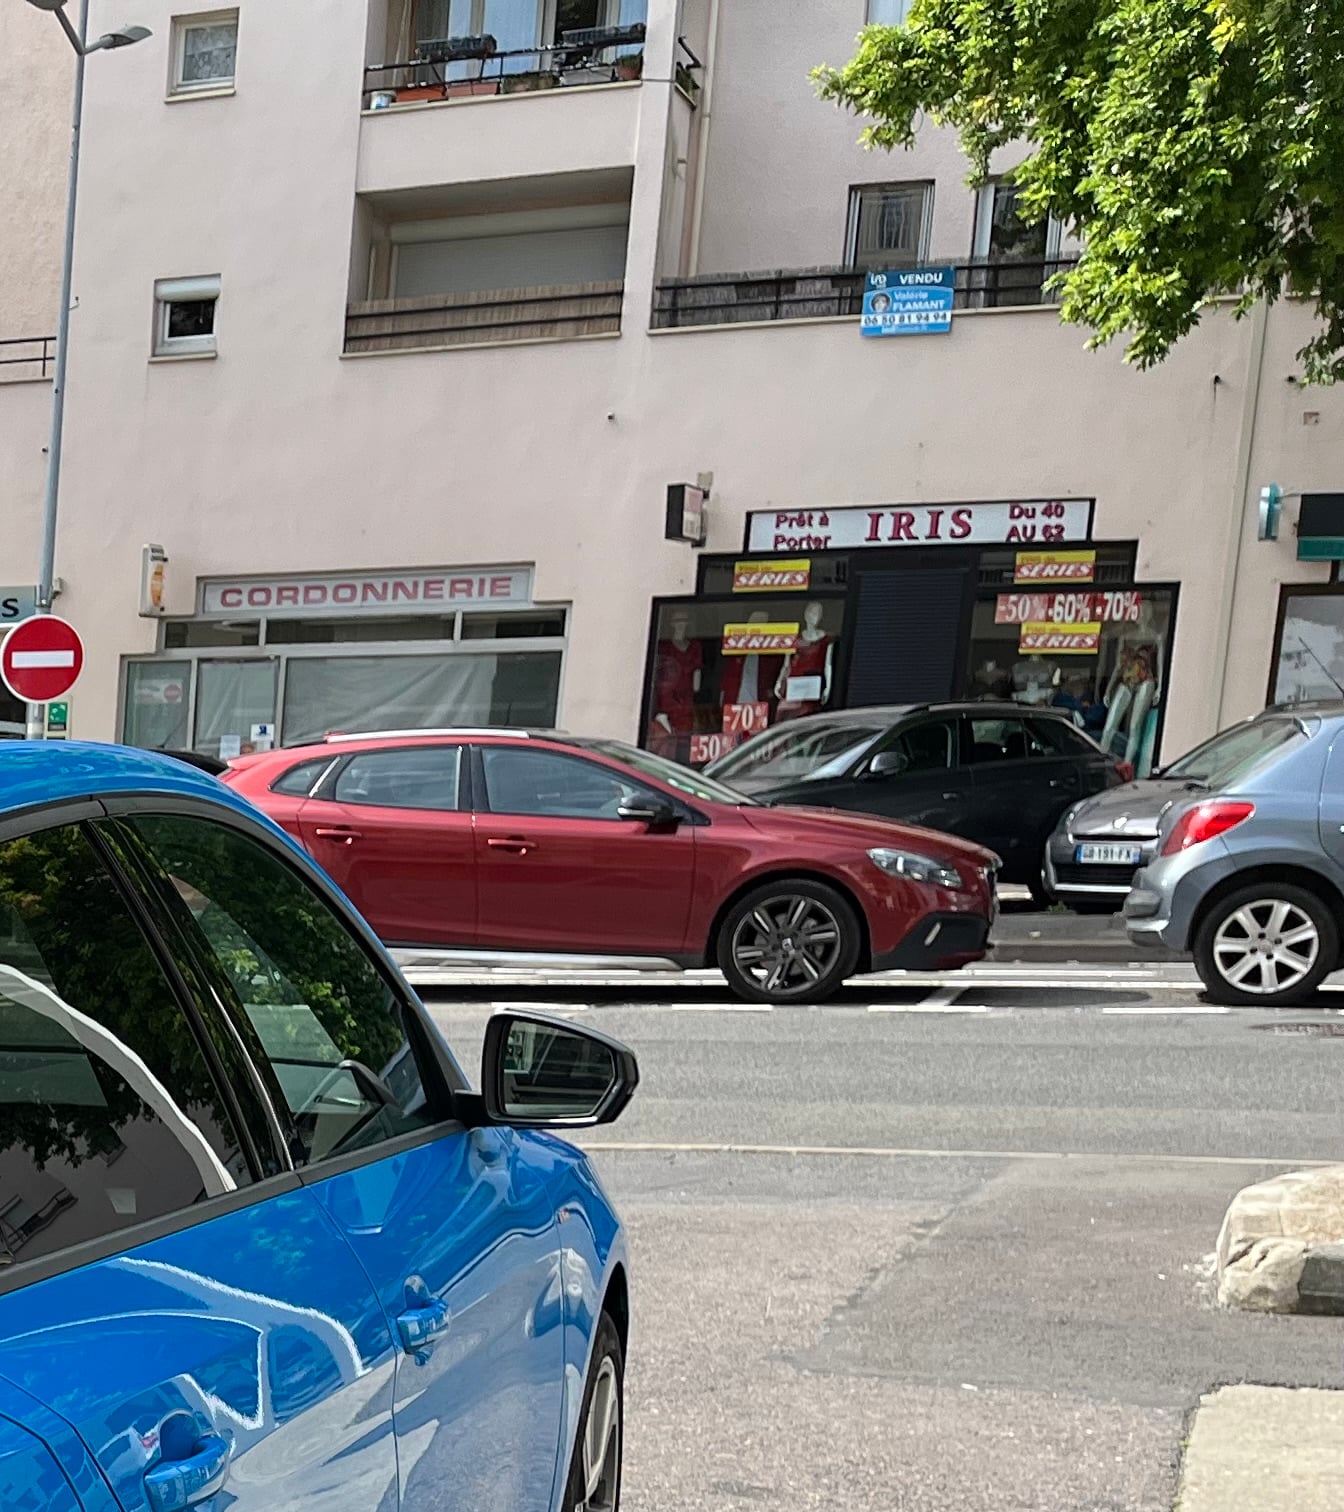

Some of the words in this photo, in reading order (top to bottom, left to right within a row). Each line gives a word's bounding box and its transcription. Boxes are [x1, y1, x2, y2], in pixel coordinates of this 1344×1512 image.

[899, 272, 943, 285] VENDU
[892, 300, 945, 312] FLAMANT
[775, 511, 813, 529] Prêt
[1009, 502, 1036, 520] Du
[1041, 501, 1065, 519] 40
[864, 509, 974, 543] IRIS
[1005, 524, 1036, 543] AU
[773, 533, 832, 552] Porter
[219, 576, 514, 608] CORDONNERIE
[1048, 593, 1091, 624] -60%
[1095, 591, 1139, 622] -70%
[723, 704, 768, 730] -70%
